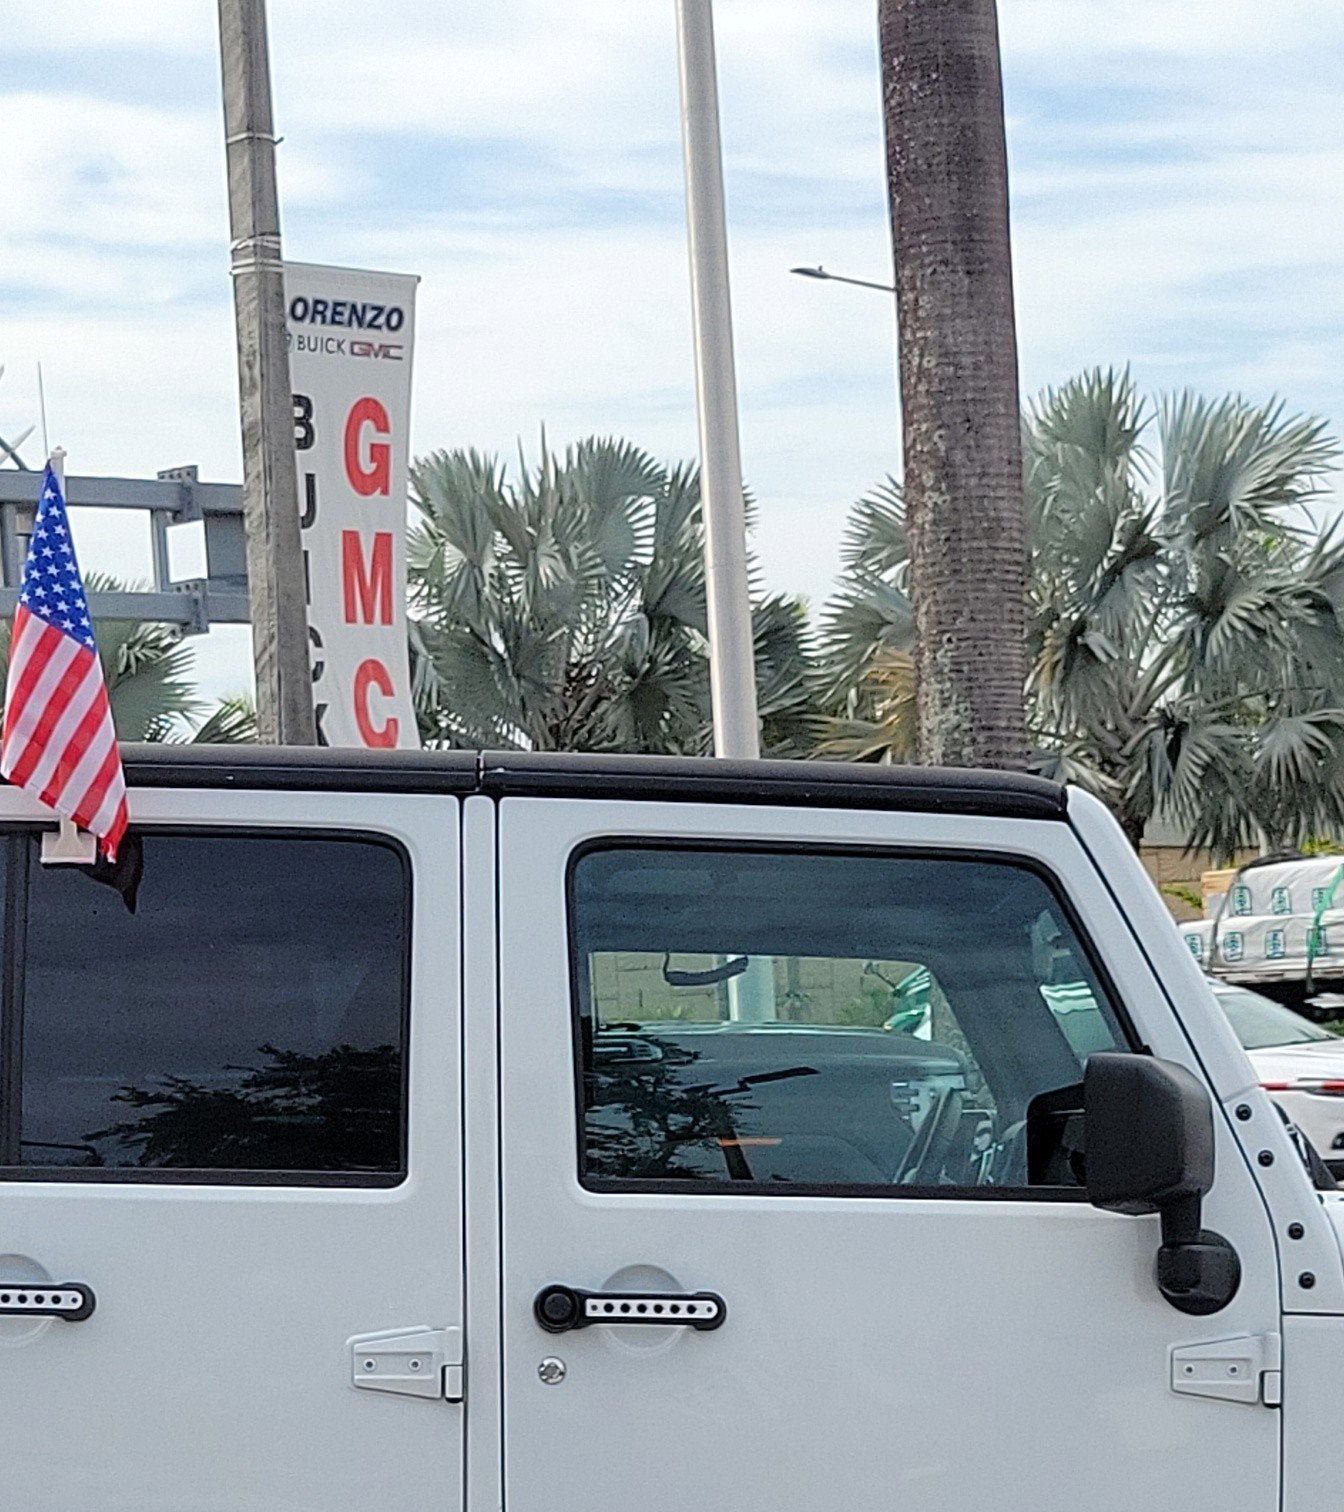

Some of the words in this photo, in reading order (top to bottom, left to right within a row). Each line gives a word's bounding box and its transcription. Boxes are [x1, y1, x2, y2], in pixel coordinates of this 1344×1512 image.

[290, 296, 404, 332] ORENZO
[297, 334, 346, 355] BUICK
[350, 340, 403, 361] GMC
[342, 396, 399, 749] GMC
